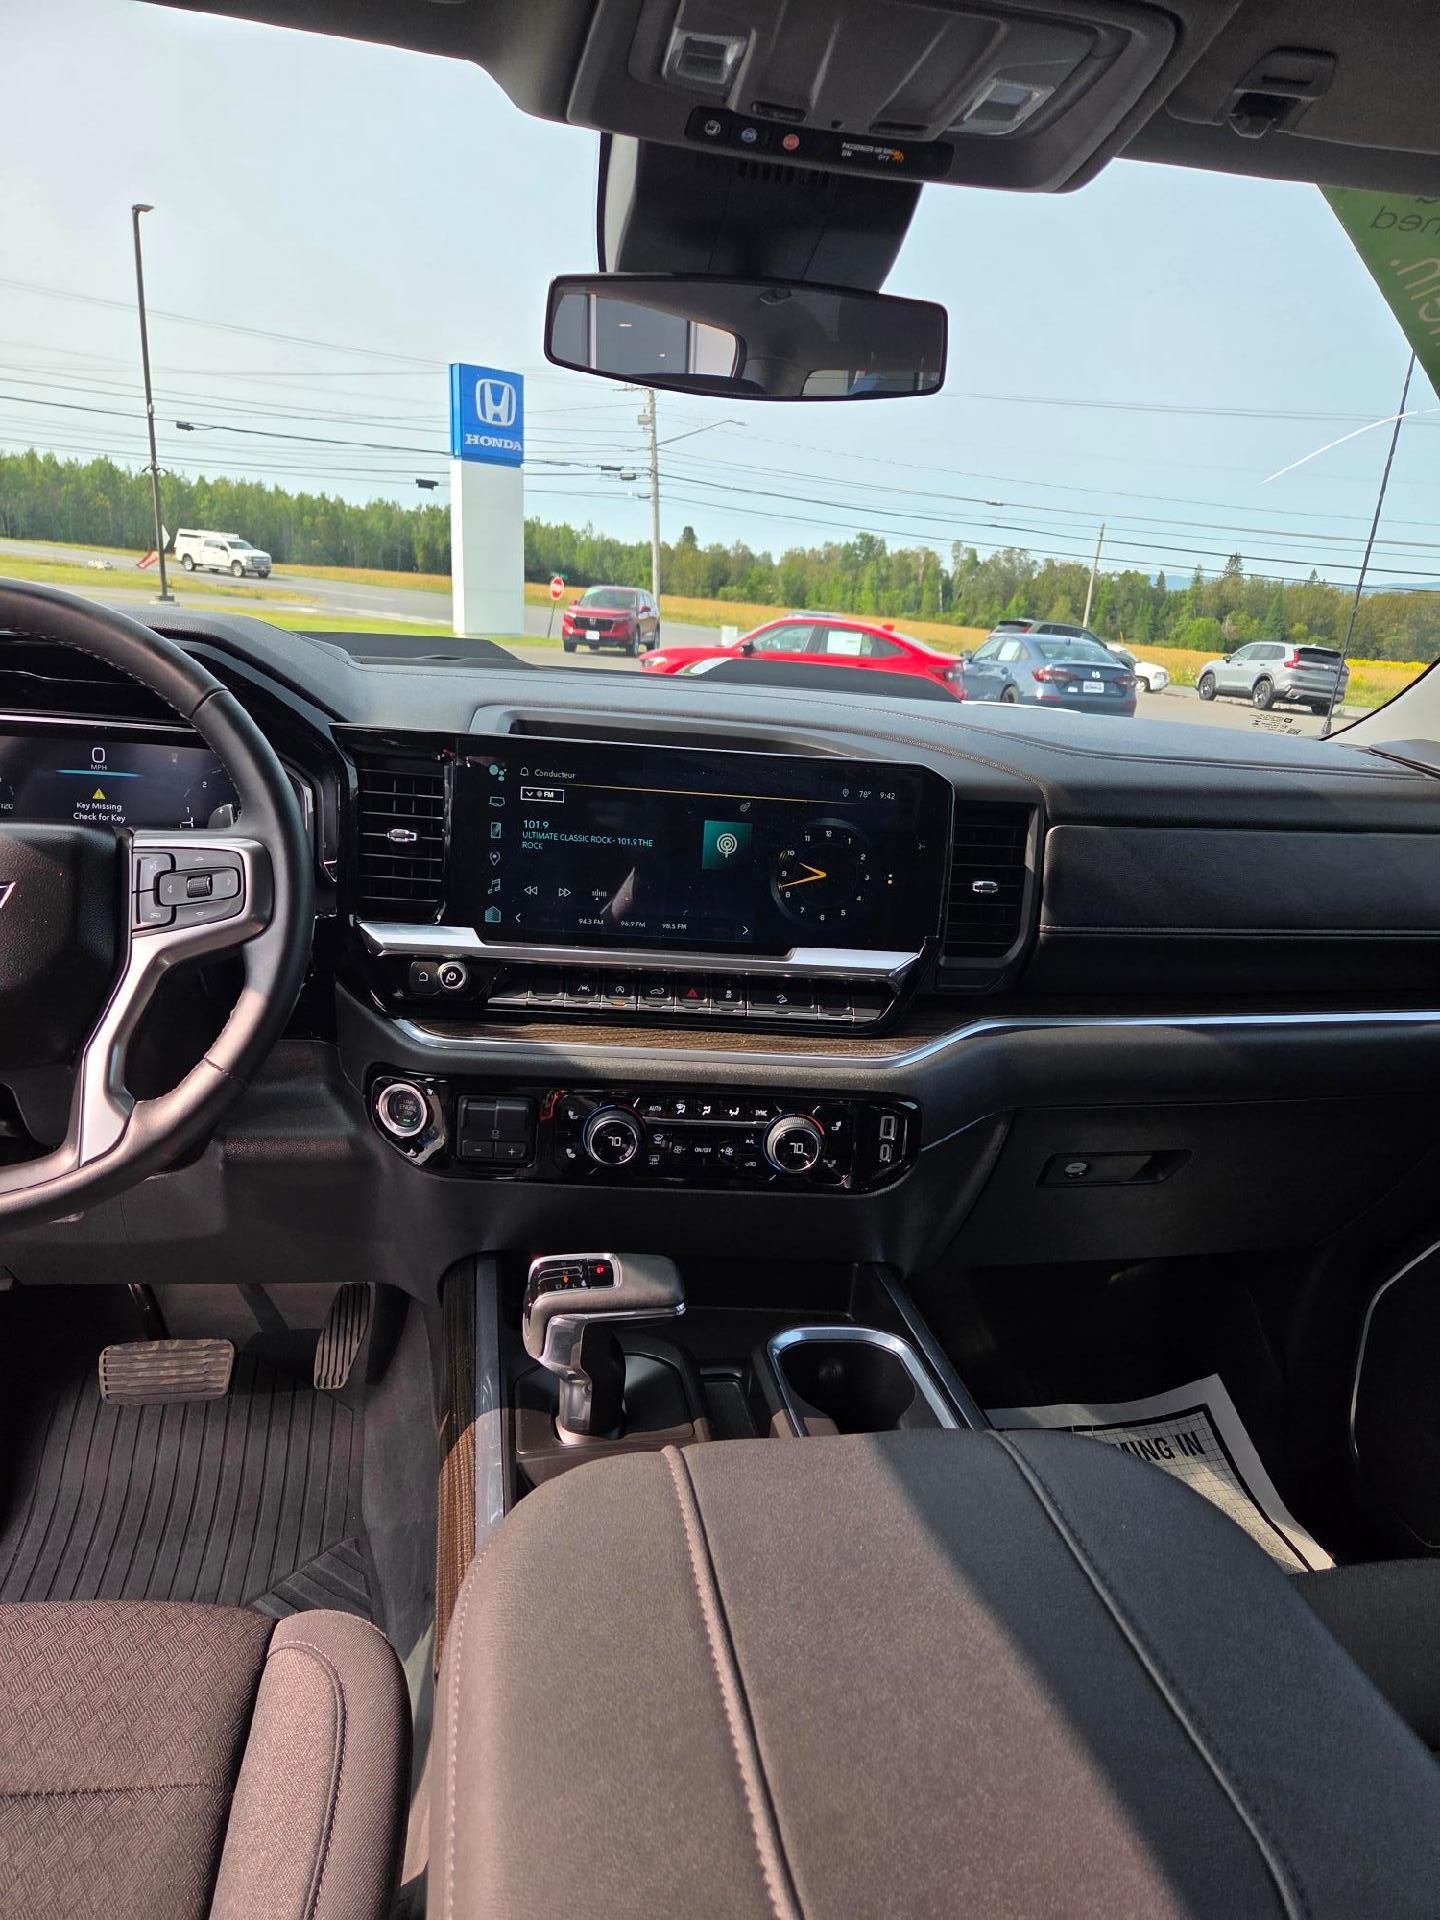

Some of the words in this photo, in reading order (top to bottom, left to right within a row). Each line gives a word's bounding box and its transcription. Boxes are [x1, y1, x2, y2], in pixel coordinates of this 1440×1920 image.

[465, 433, 523, 451] HONDA
[534, 769, 576, 780] Conducteur
[880, 791, 896, 800] 9:42
[76, 801, 91, 811] Key
[92, 802, 122, 813] Missing
[73, 812, 97, 821] Check
[99, 812, 110, 821] for
[111, 814, 126, 824] Key
[522, 831, 559, 841] ULTIMATE
[560, 833, 589, 843] CLASSIC
[638, 839, 653, 847] THE
[522, 841, 544, 850] ROCK
[608, 1136, 622, 1147] 70
[789, 1142, 804, 1154] 70
[1174, 1431, 1206, 1457] IN
